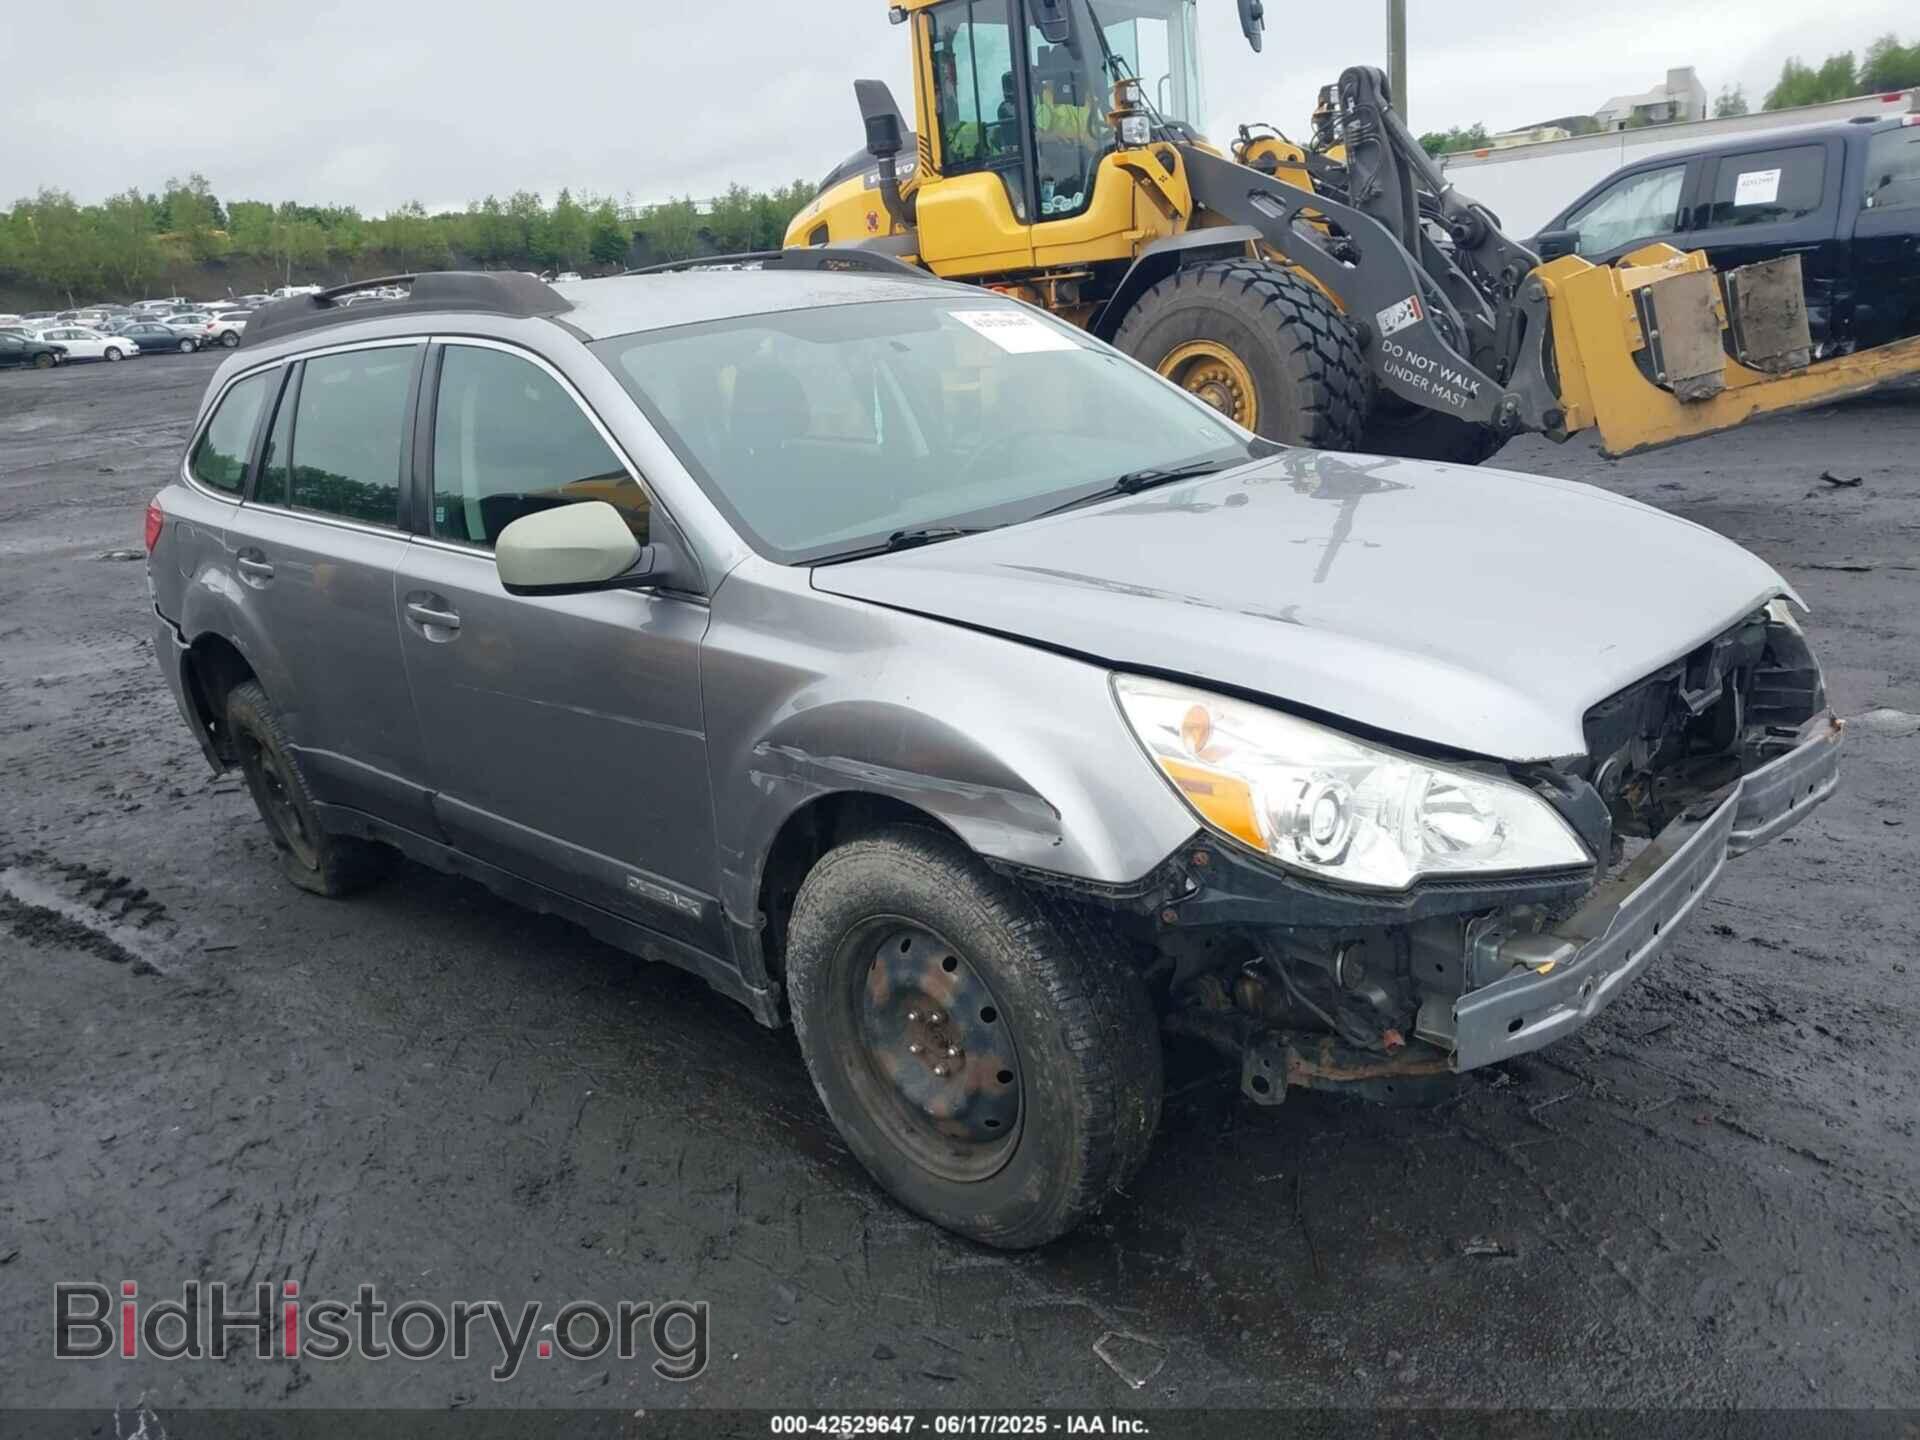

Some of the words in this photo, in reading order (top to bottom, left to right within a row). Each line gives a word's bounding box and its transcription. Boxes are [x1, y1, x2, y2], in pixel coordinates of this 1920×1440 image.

[1382, 340, 1403, 357] DO
[1406, 351, 1438, 373] NOT
[1440, 365, 1480, 395] WALK
[1384, 360, 1429, 391] UNDER
[1432, 384, 1467, 408] MAST
